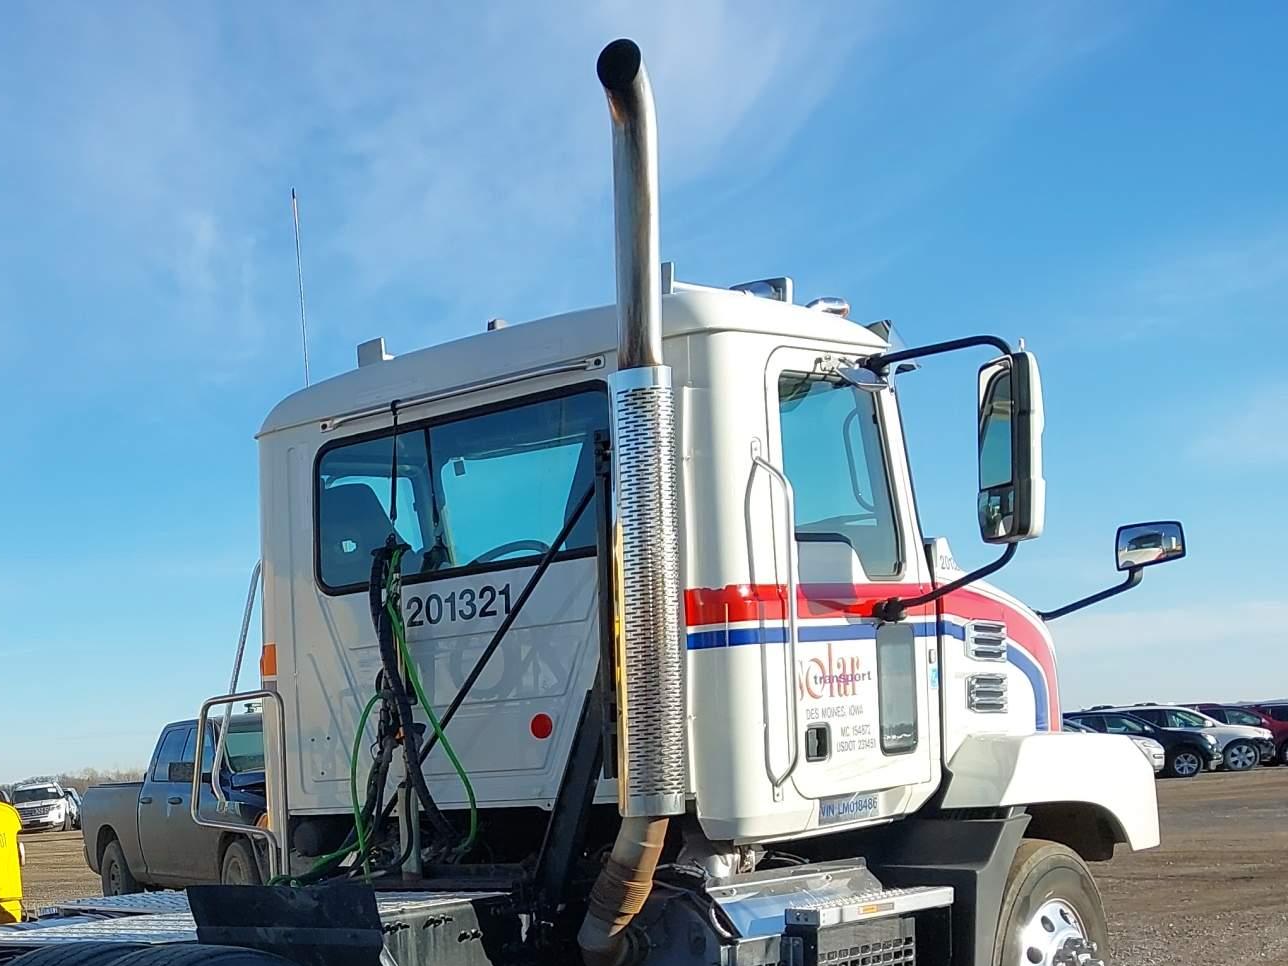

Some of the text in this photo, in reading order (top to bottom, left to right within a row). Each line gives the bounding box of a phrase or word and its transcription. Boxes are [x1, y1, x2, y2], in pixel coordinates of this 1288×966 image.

[406, 583, 512, 628] 201321
[813, 670, 872, 686] transport
[806, 707, 820, 720] DES
[848, 704, 864, 716] IOWA
[840, 725, 850, 737] MC
[836, 740, 856, 752] USDOT
[821, 804, 835, 817] VIN
